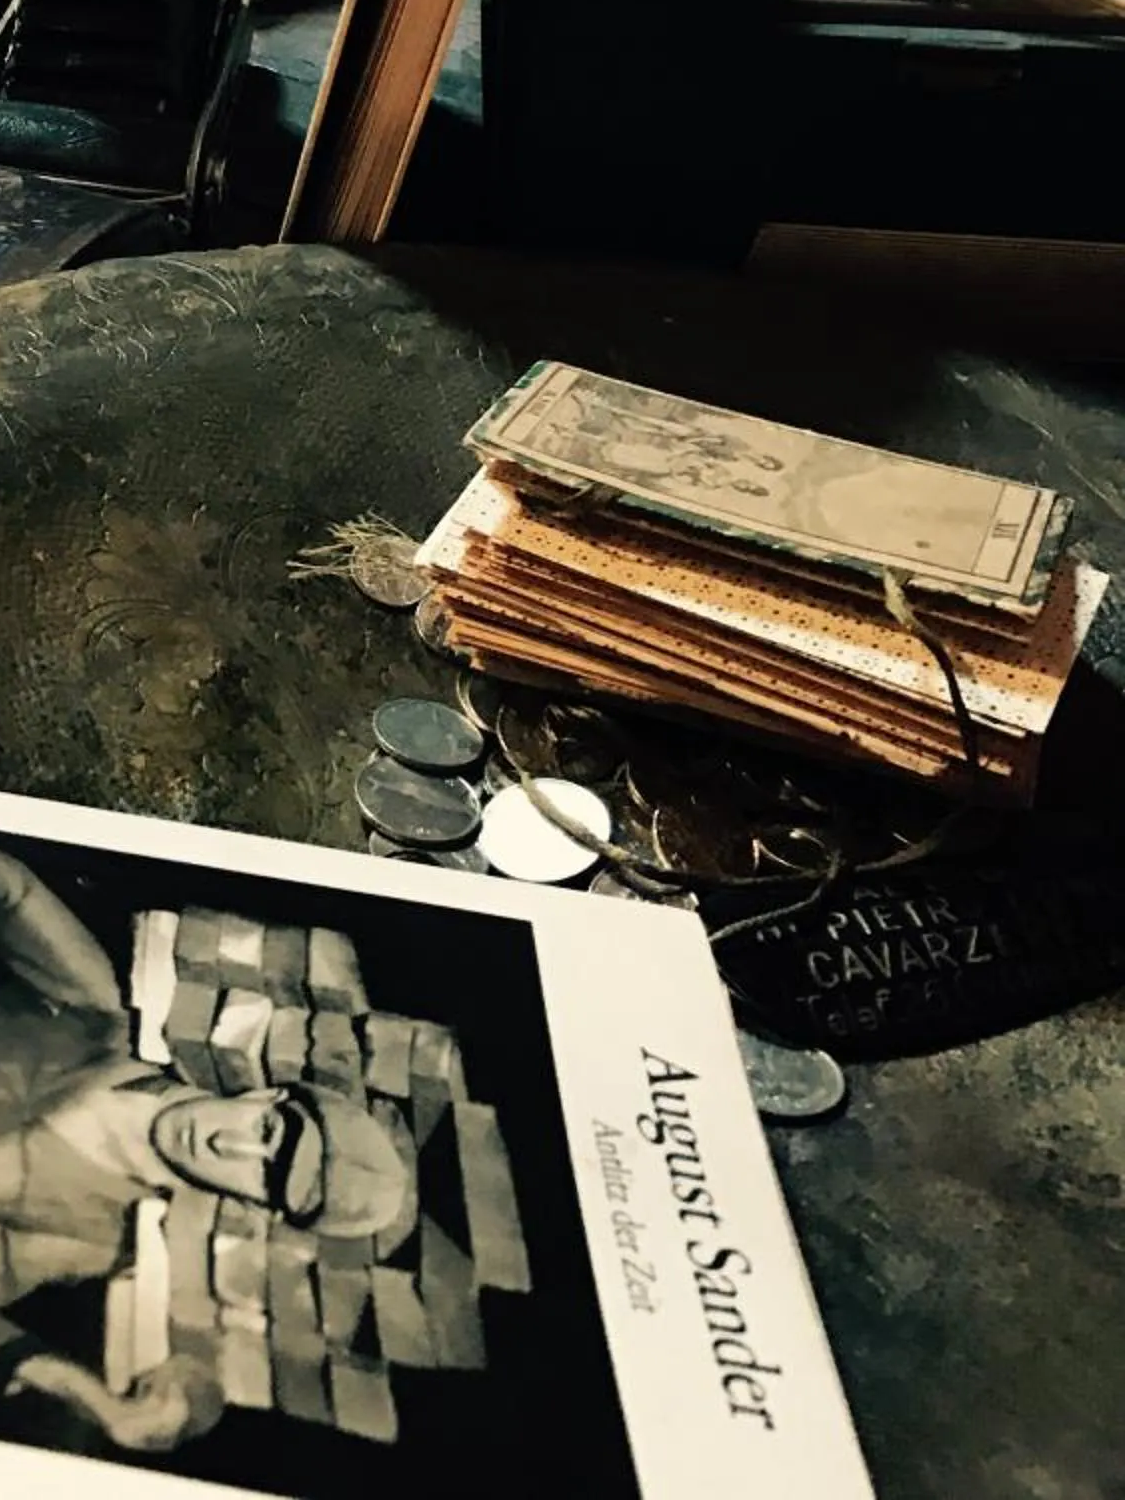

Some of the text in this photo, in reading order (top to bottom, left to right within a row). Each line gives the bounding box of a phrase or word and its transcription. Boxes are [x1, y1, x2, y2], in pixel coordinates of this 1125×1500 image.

[610, 1209, 647, 1254] der
[636, 1046, 784, 1432] August Sander
[621, 1257, 658, 1315] Zeit
